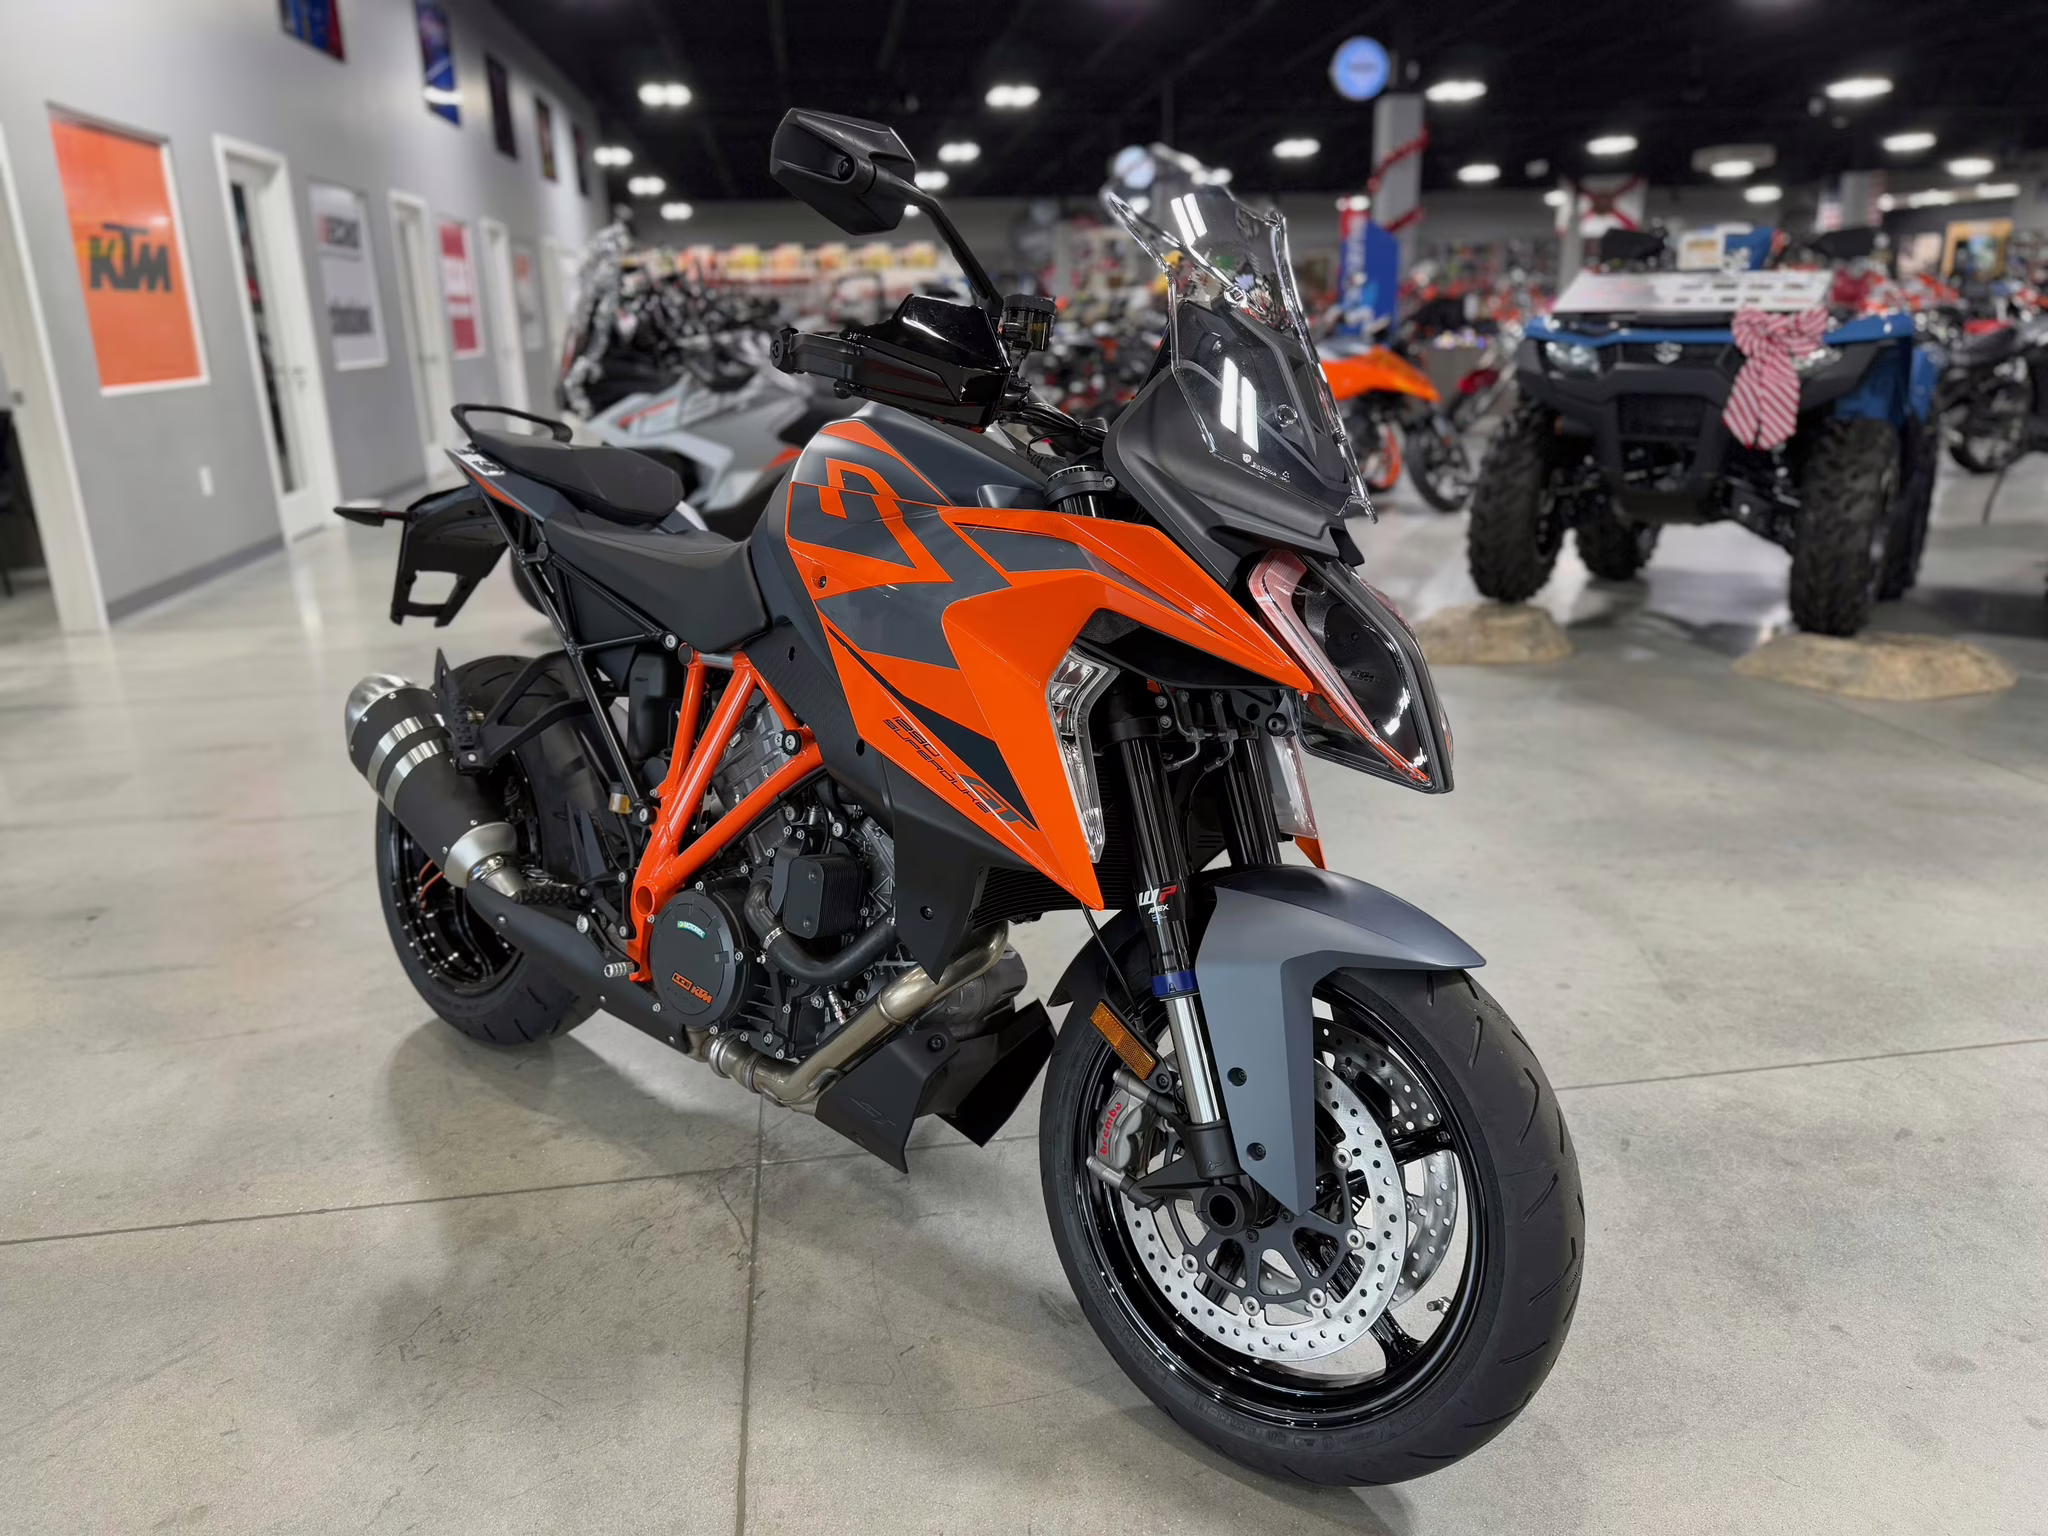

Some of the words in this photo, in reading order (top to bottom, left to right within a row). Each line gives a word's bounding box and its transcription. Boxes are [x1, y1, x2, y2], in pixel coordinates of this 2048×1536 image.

[89, 223, 172, 292] KTM
[893, 716, 941, 758] 1290
[957, 773, 1037, 832] GT
[1139, 885, 1179, 906] WP
[1148, 904, 1170, 914] APEX
[691, 986, 713, 1004] KTM
[1100, 1103, 1122, 1156] brembo
